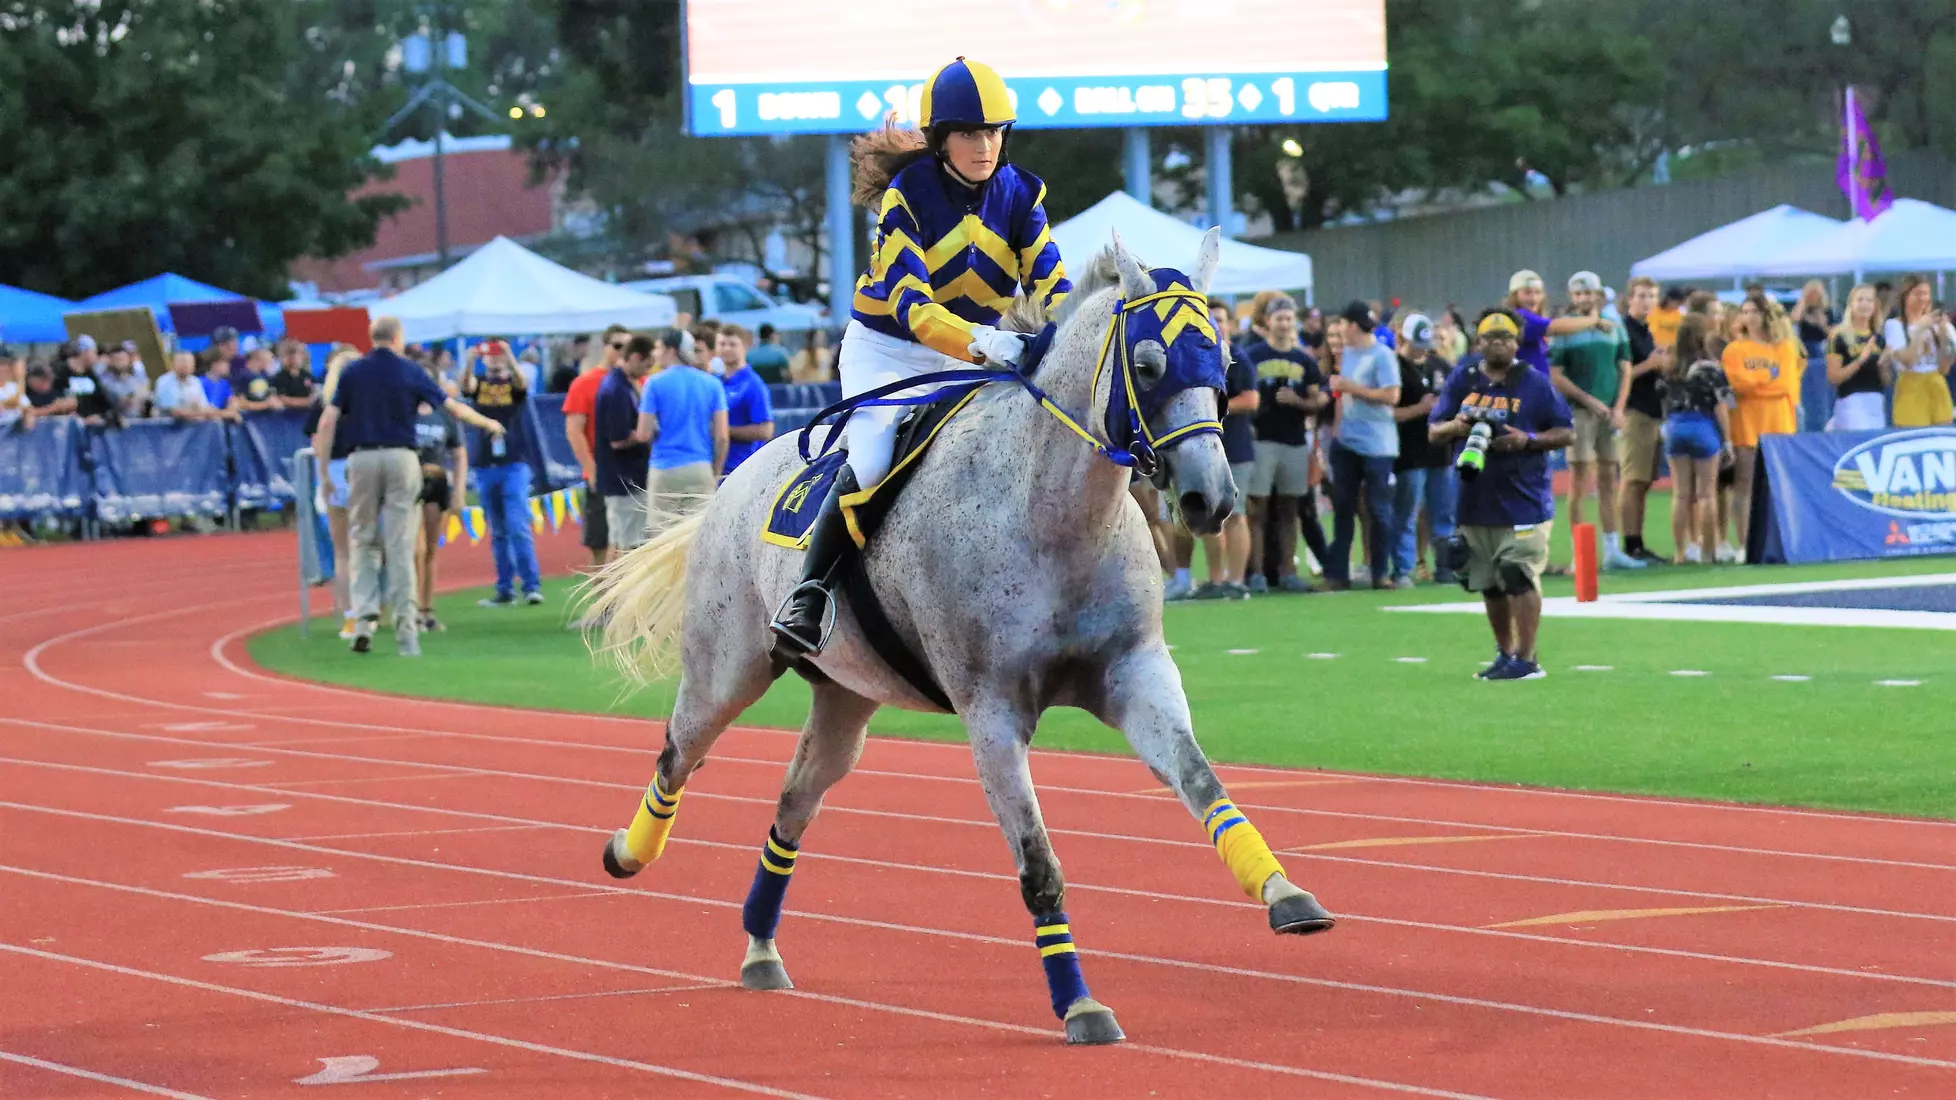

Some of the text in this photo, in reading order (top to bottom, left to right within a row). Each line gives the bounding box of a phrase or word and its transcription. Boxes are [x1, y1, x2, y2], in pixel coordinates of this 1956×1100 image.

[711, 88, 737, 128] 1
[1181, 77, 1234, 118] 35
[1271, 76, 1295, 115] 1
